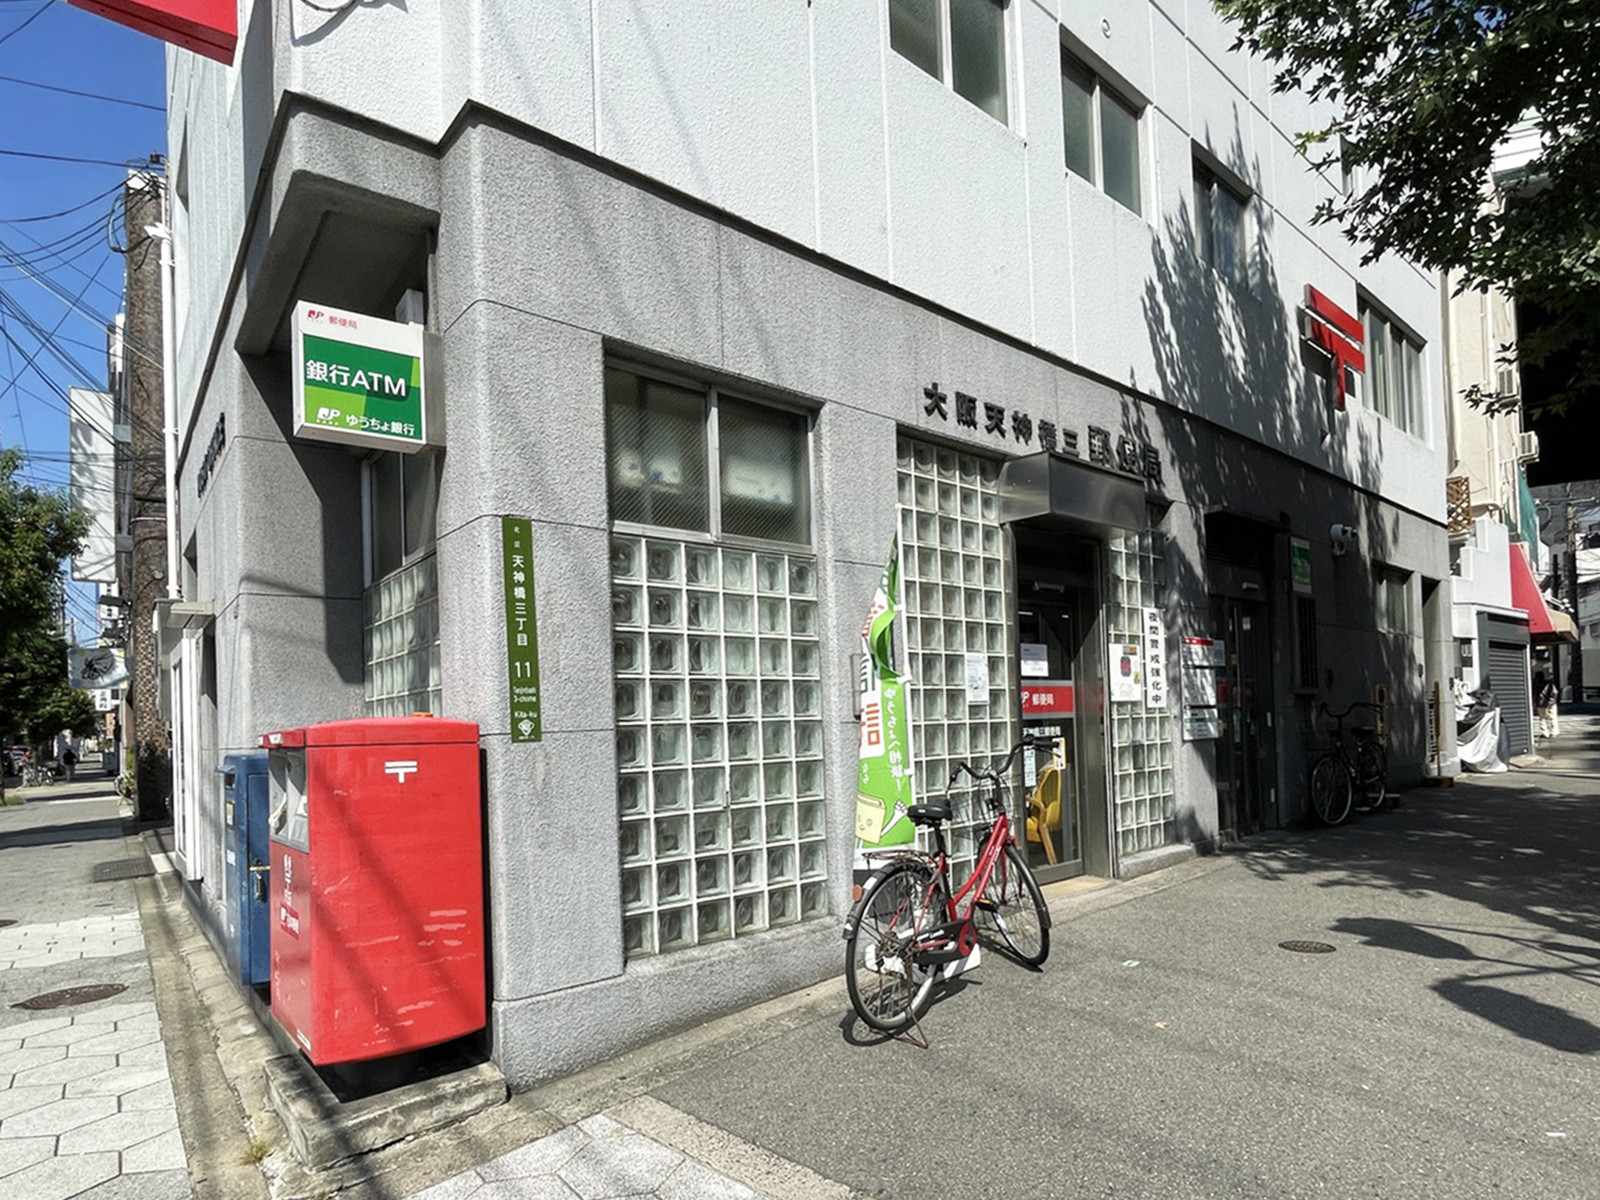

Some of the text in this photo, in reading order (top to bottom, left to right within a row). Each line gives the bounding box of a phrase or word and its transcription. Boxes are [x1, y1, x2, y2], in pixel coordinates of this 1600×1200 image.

[306, 359, 406, 397] 銀行ATM
[345, 414, 415, 436] ゆうちょ銀行
[514, 661, 531, 678] 11
